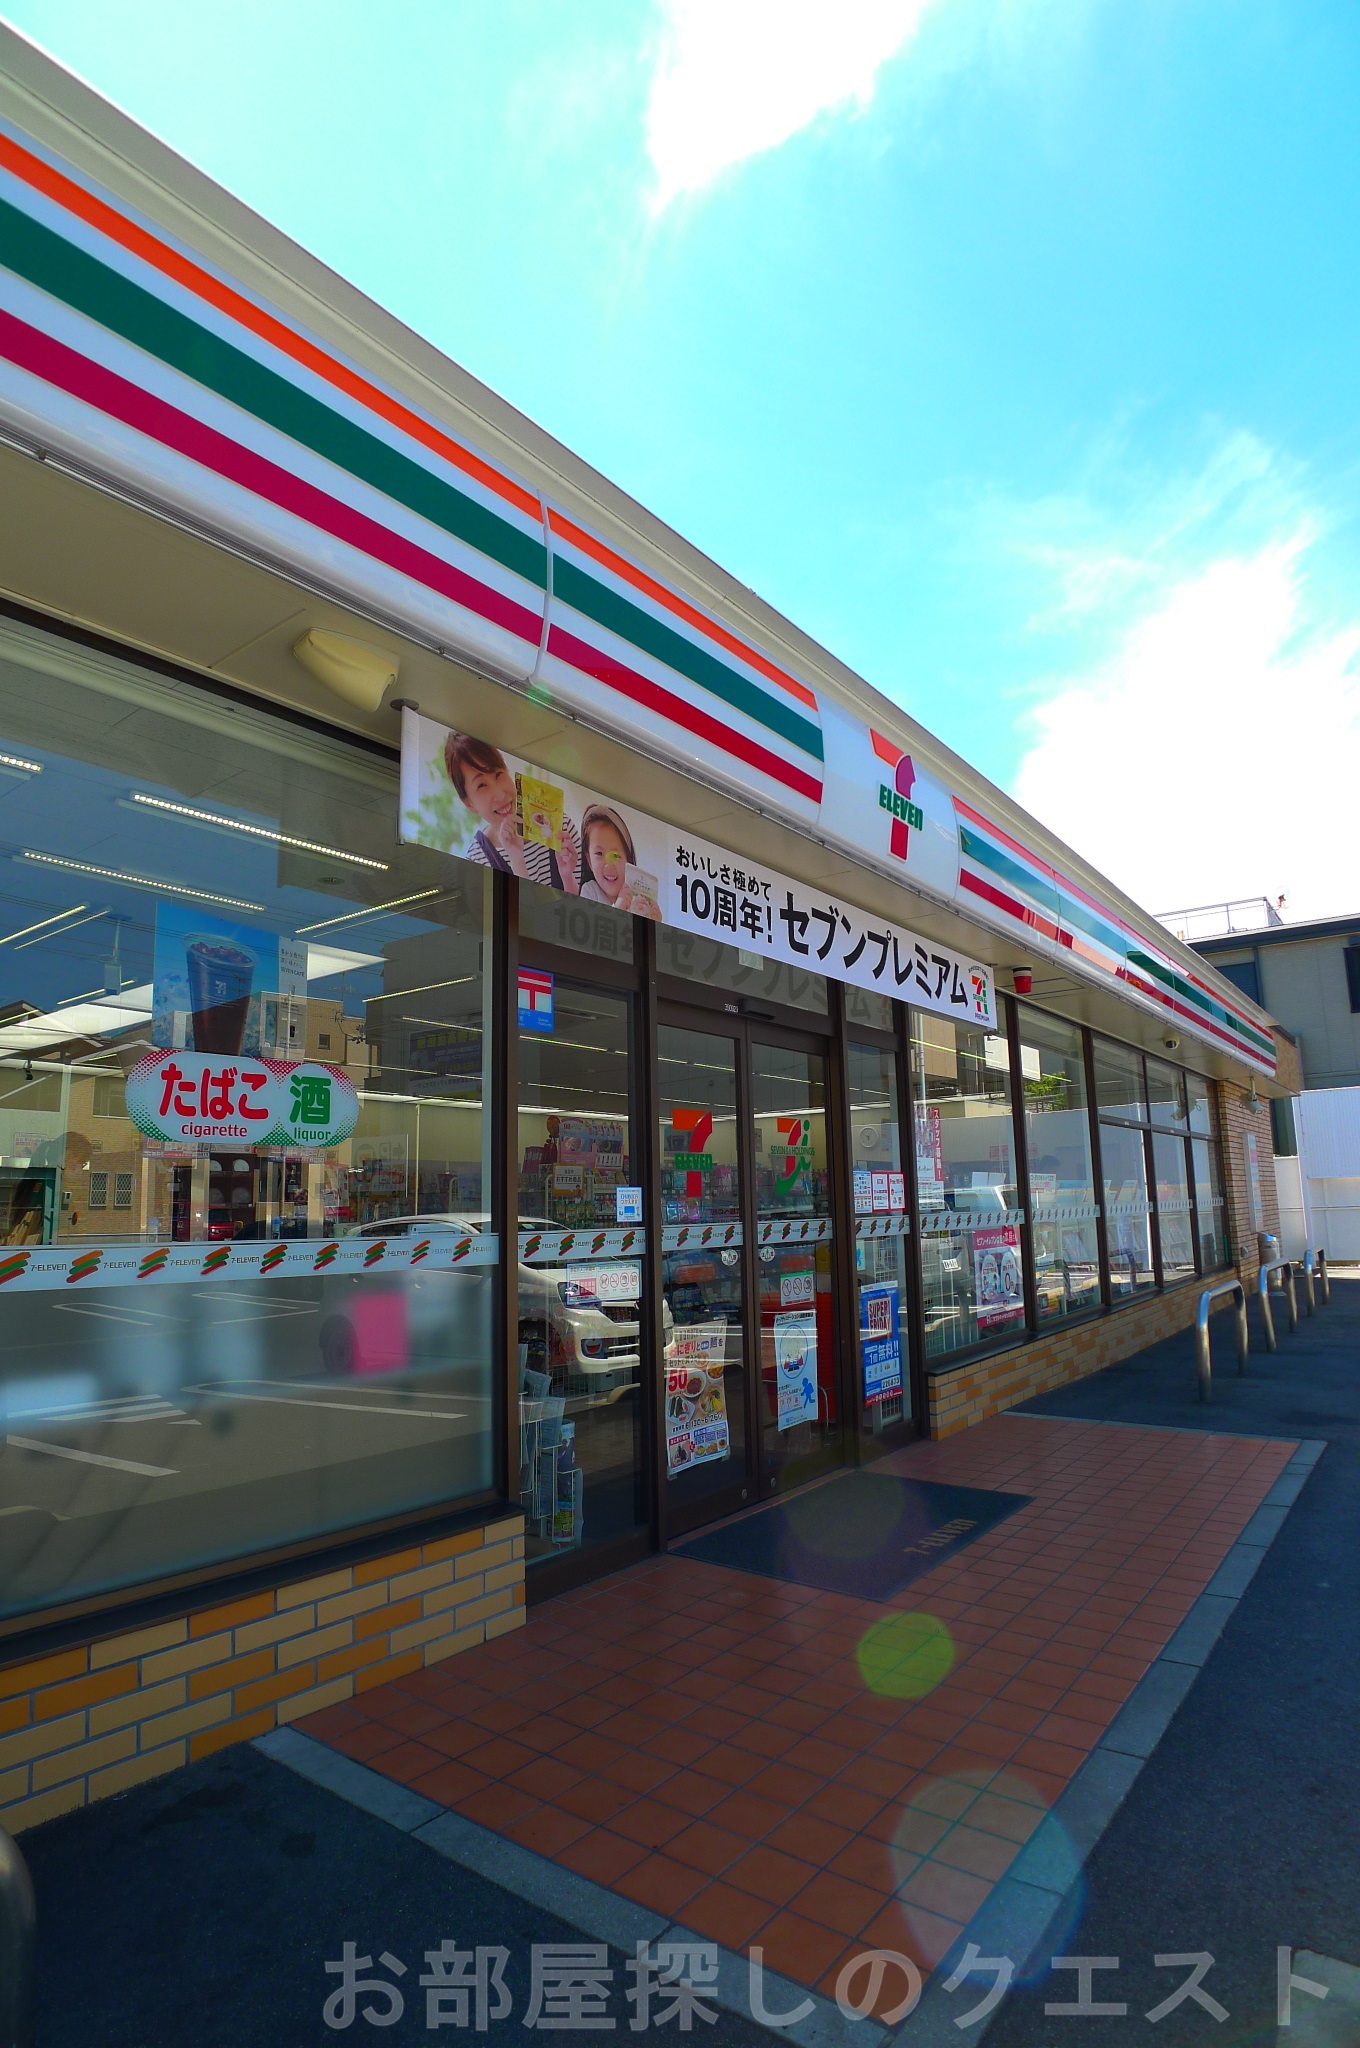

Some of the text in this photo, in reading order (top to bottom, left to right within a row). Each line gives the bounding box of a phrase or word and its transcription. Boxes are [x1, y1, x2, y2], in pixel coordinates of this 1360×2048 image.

[675, 845, 772, 901] おいしさ極めて
[779, 890, 969, 1008] セブンプレミアム
[159, 1062, 332, 1126] たばこ 酒
[181, 1121, 332, 1142] cigarette liquor
[869, 1315, 891, 1331] FRIDAY
[668, 1367, 688, 1392] 50
